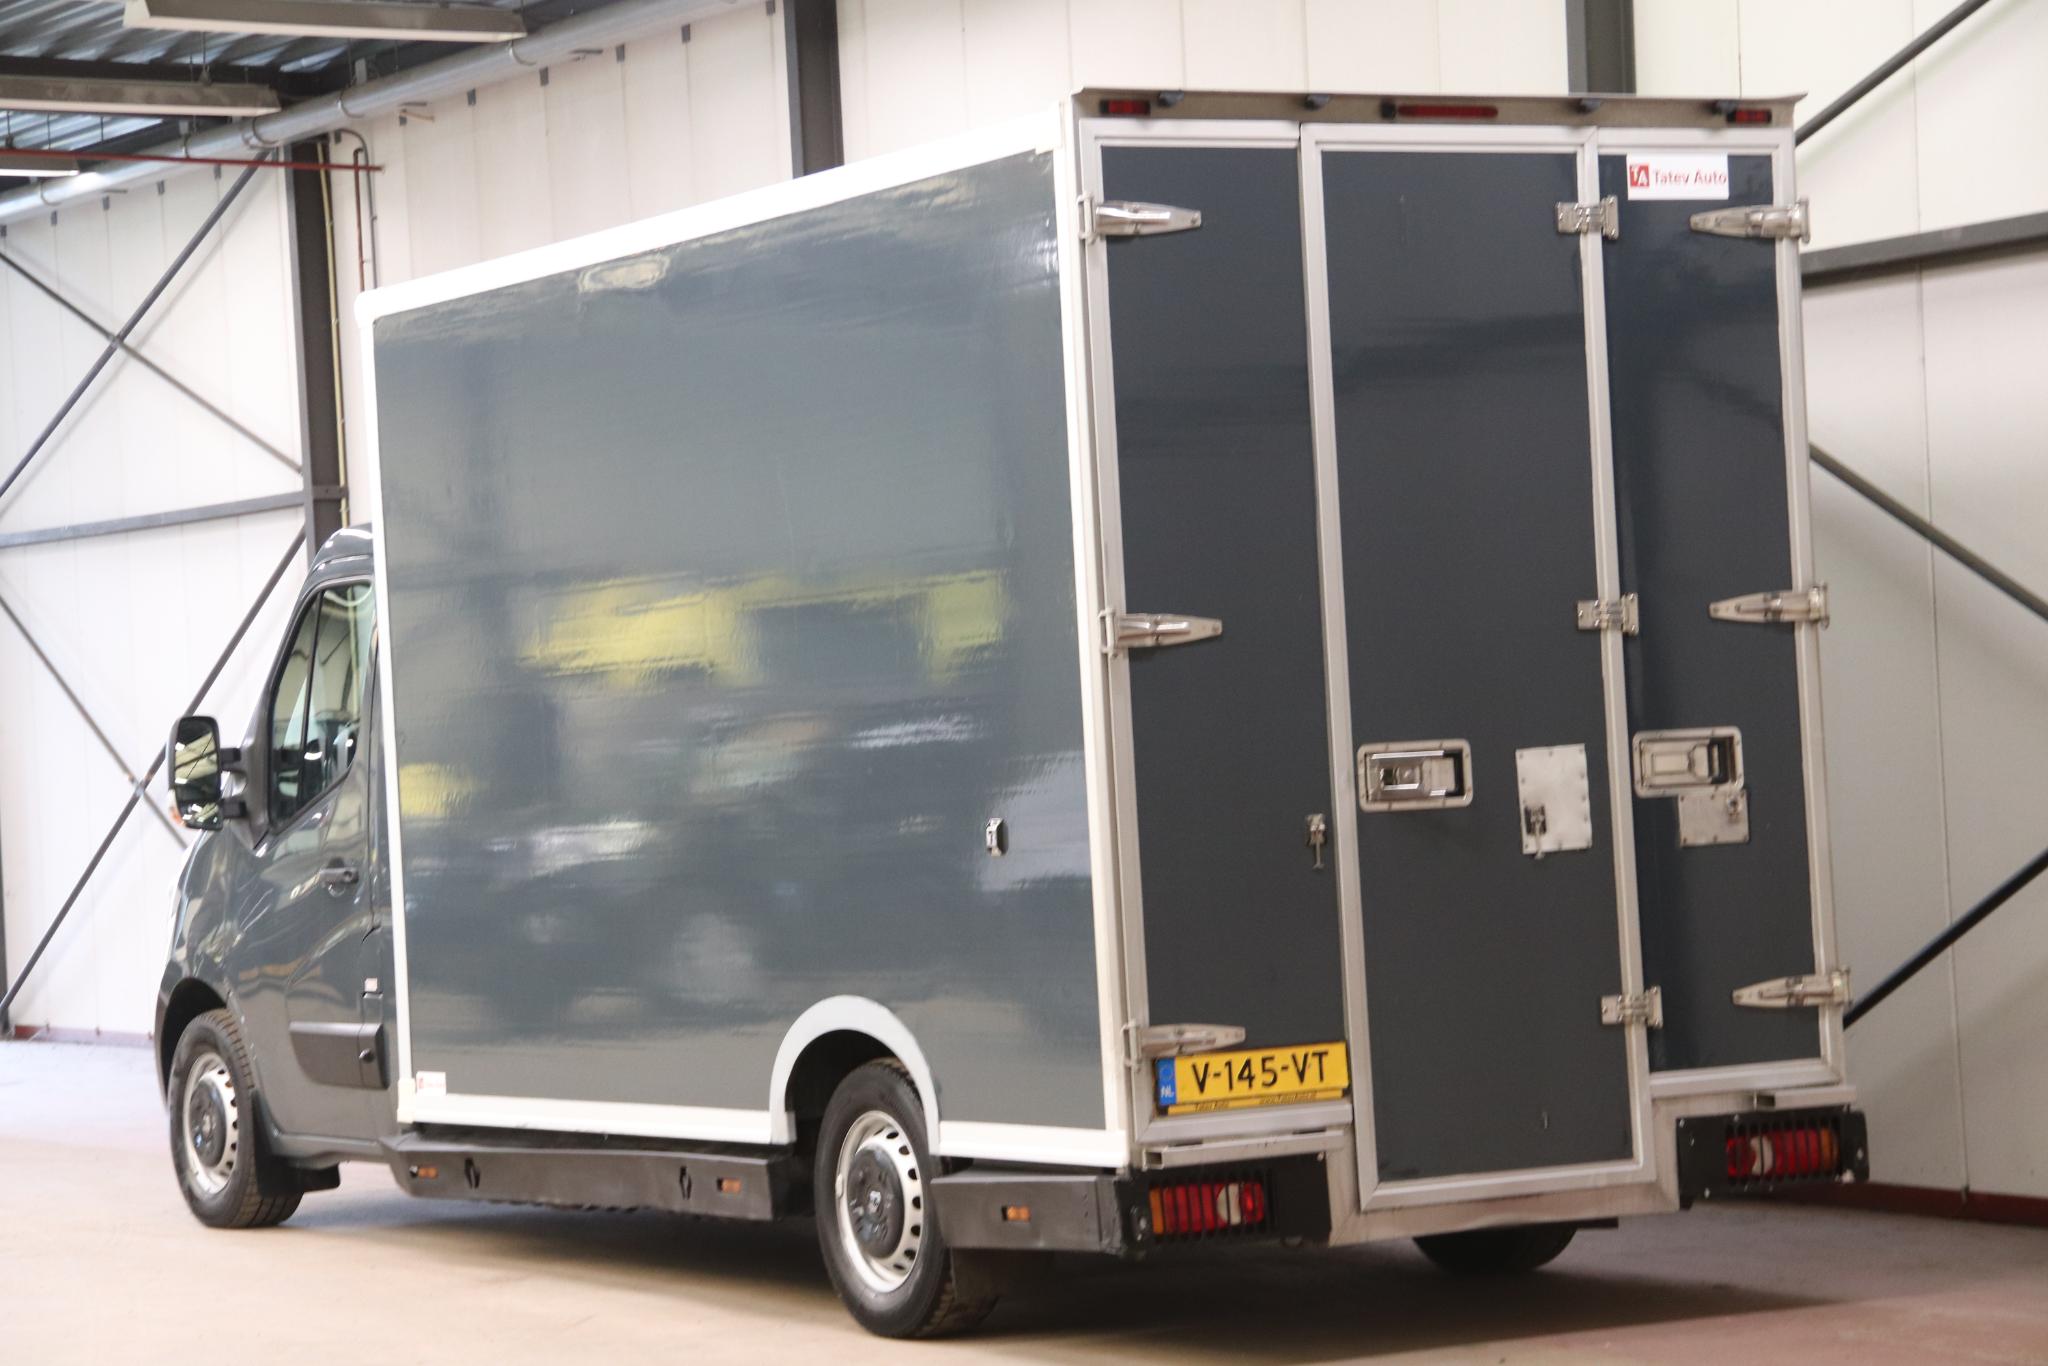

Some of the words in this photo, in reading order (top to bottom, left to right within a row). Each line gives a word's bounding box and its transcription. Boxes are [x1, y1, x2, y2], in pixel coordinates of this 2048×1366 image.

[1655, 170, 1691, 184] Tatev
[1694, 170, 1727, 184] Auto
[1160, 1085, 1174, 1098] NL
[1191, 1051, 1329, 1094] V-145-VT
